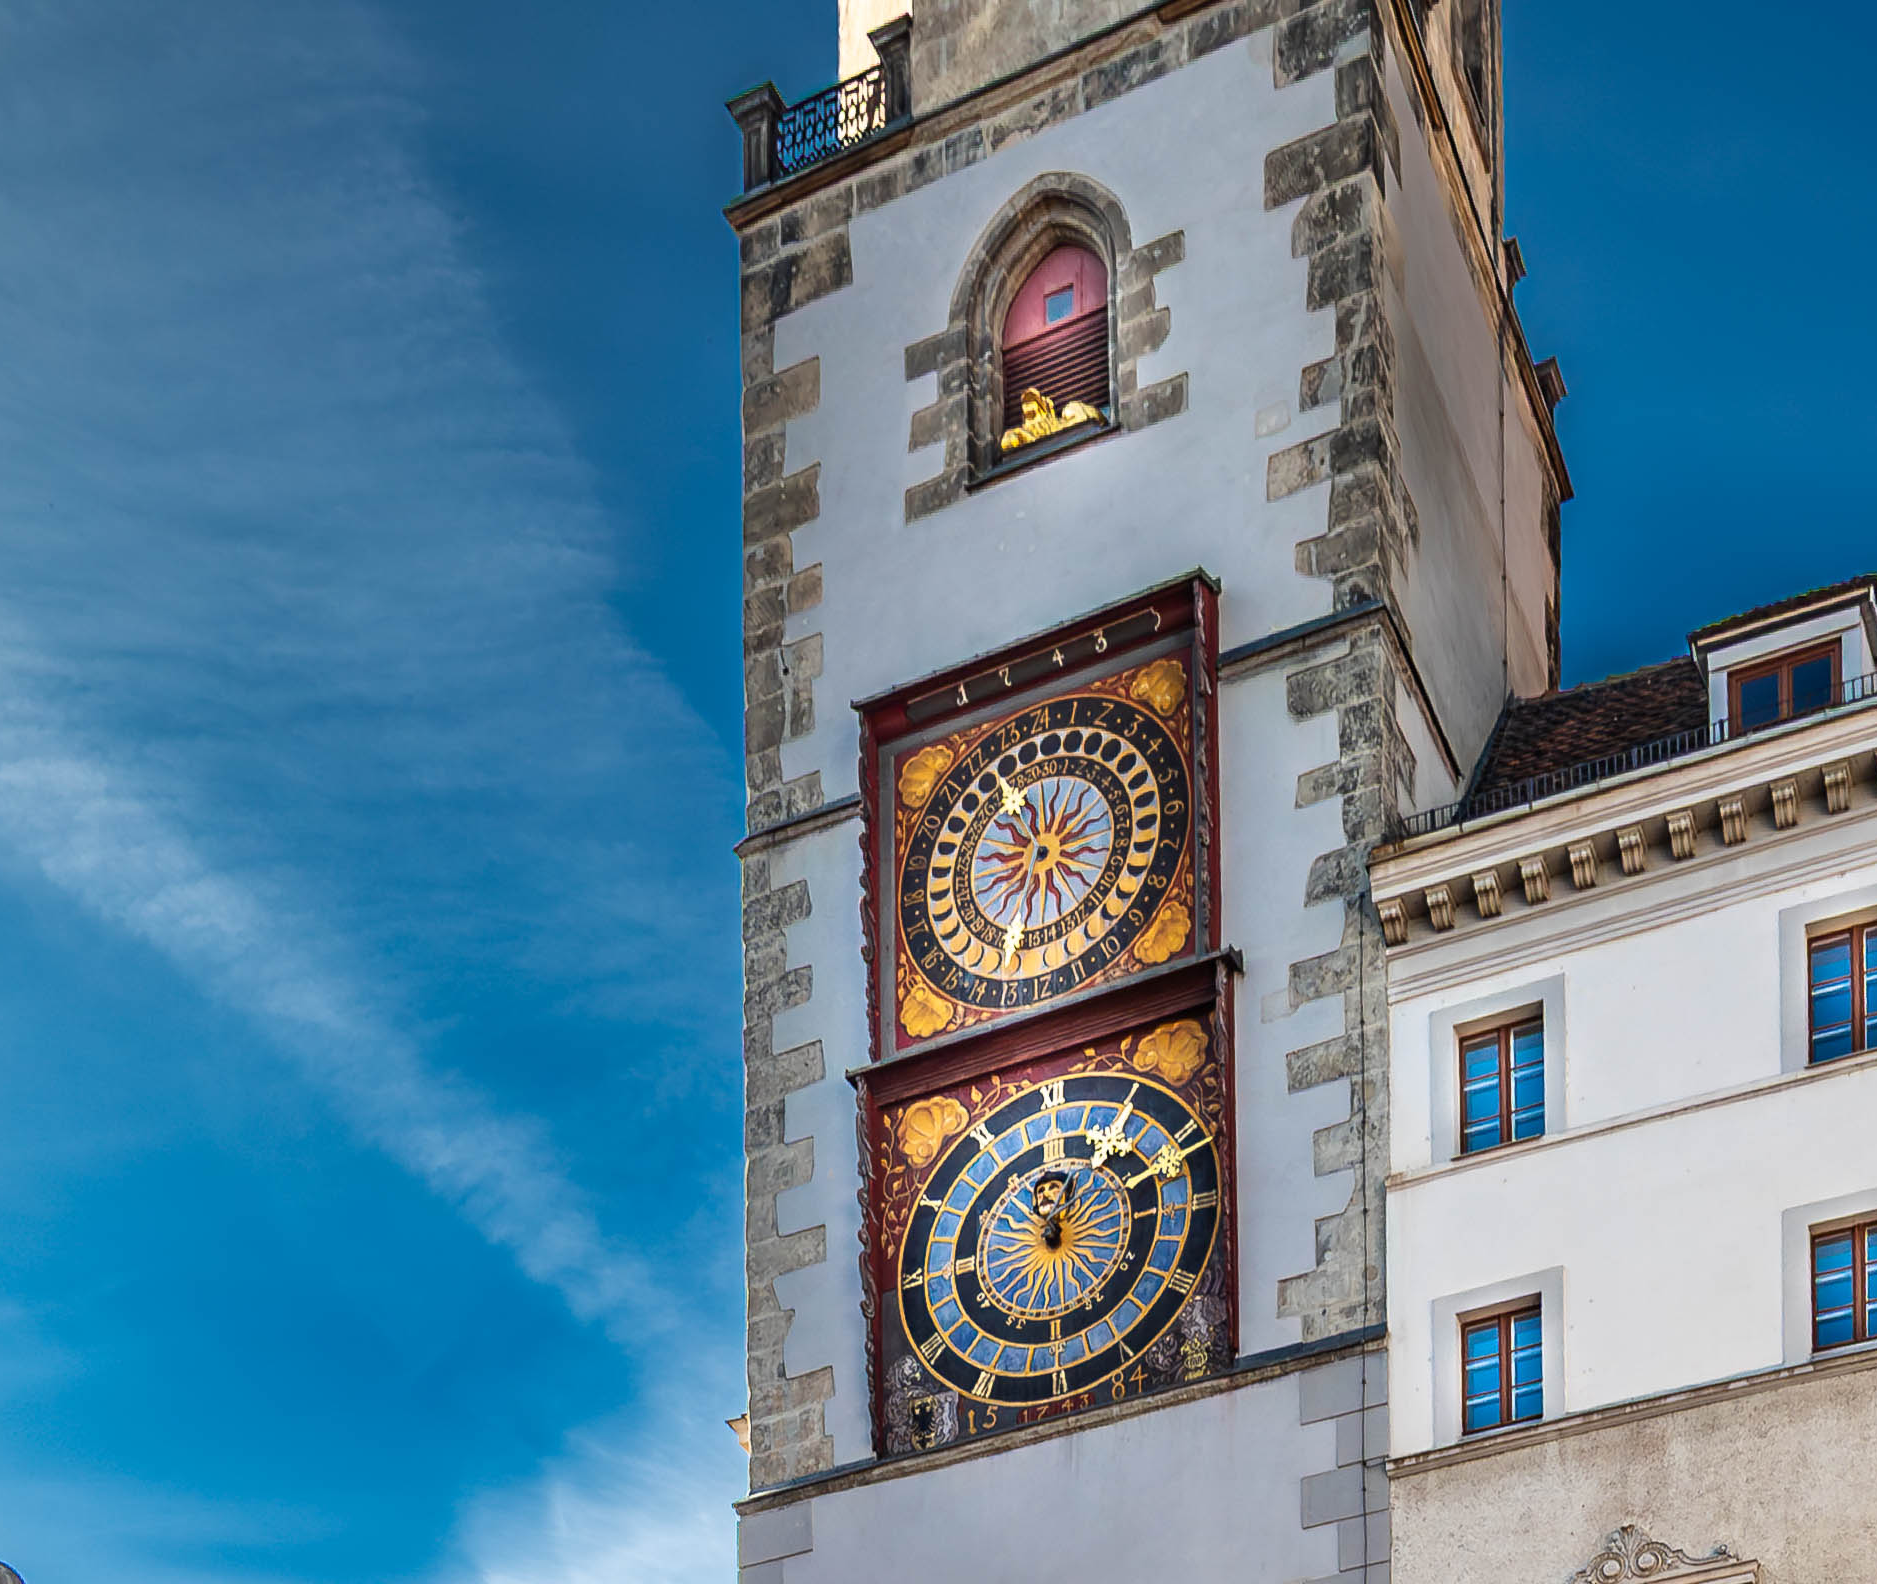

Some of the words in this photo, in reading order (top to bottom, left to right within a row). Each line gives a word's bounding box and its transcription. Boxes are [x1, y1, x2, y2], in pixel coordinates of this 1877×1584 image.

[1030, 706, 1051, 735] 24
[1069, 701, 1078, 725] 1
[1093, 701, 1115, 728] 2
[1124, 713, 1144, 737] 3
[997, 721, 1020, 750] 23
[962, 747, 989, 776] 22
[1157, 767, 1178, 783] 5
[939, 780, 962, 804] 21
[1164, 800, 1184, 815] 6
[917, 815, 941, 840] 20
[1147, 874, 1167, 888] 8
[903, 889, 924, 907] 18
[1128, 908, 1144, 926] 9
[921, 946, 944, 969] 16
[1100, 936, 1121, 960] 10
[941, 967, 962, 990] 15
[1071, 959, 1086, 983] 11
[969, 979, 987, 1001] 14
[1002, 981, 1018, 1003] 13
[1033, 975, 1052, 998] 12
[1039, 1079, 1065, 1111] XII
[1174, 1118, 1198, 1143] II
[1111, 1364, 1148, 1401] 84
